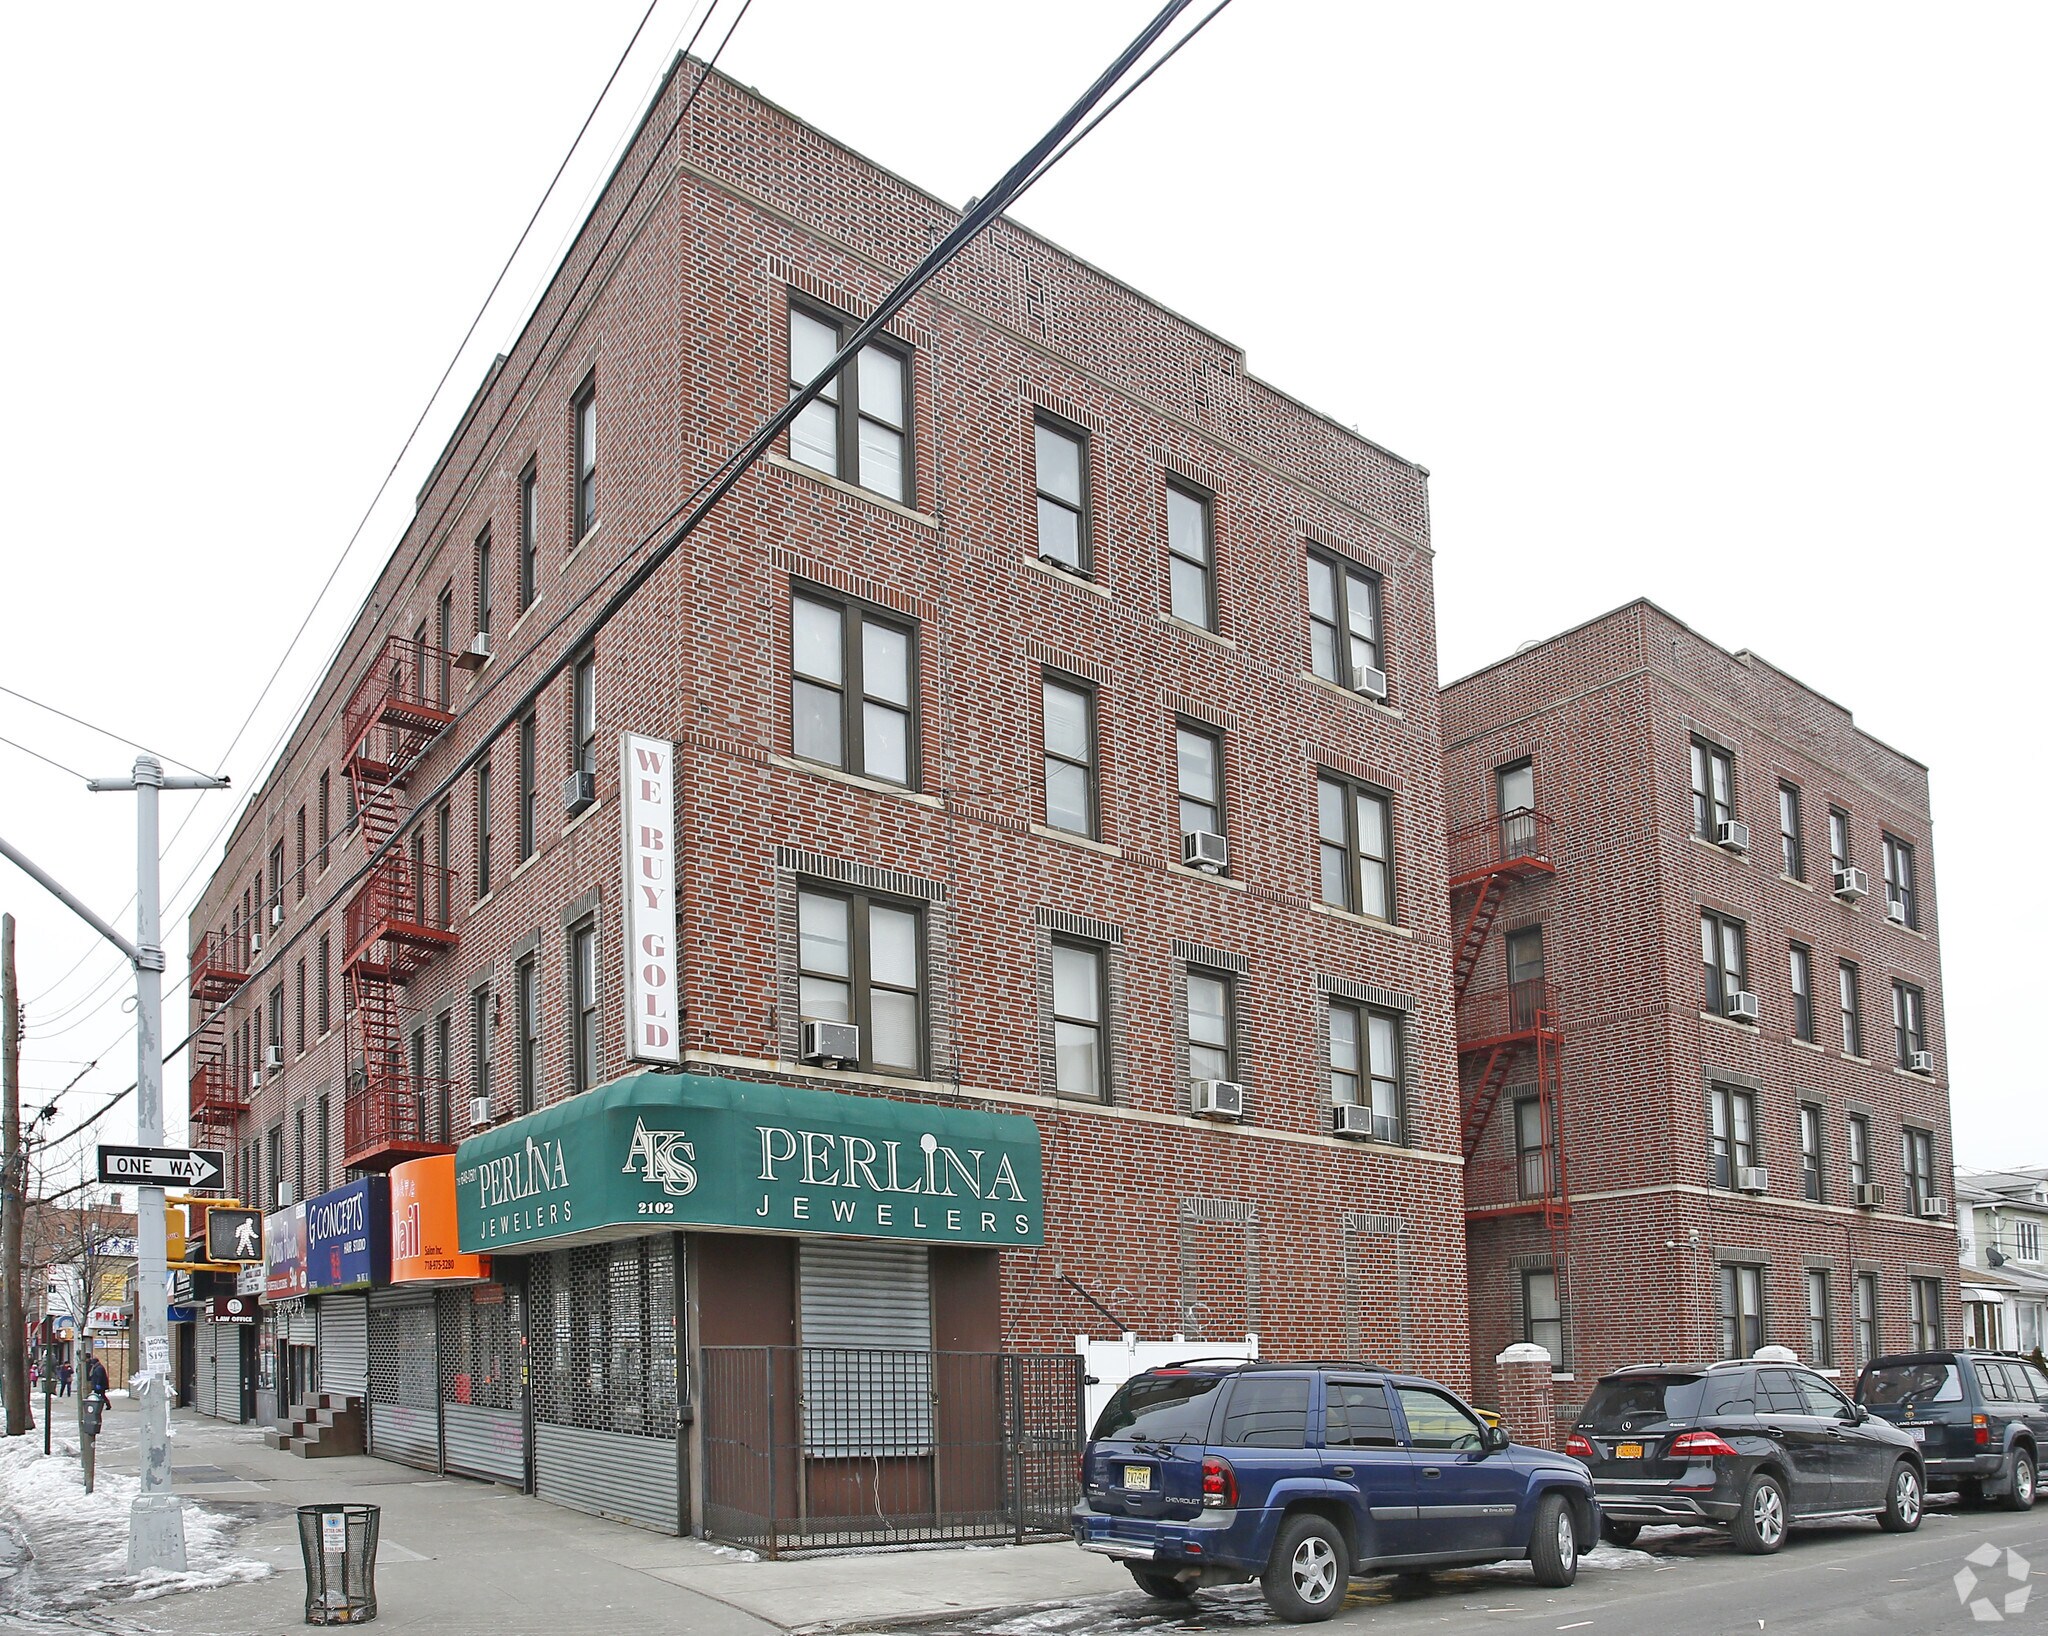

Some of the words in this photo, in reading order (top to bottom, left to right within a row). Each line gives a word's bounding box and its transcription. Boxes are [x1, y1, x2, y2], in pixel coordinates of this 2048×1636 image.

[634, 747, 667, 805] WE
[640, 825, 666, 910] BUY
[641, 933, 669, 1048] GOLD
[117, 1158, 152, 1174] ONE
[169, 1160, 205, 1176] WAY
[478, 1135, 570, 1209] PERLINA
[755, 1126, 1028, 1202] PERLINA
[316, 1191, 364, 1240] CONCEPTS
[480, 1200, 573, 1240] JEWELERS
[637, 1202, 674, 1215] 2102
[756, 1194, 1030, 1236] JEWELERS
[343, 1240, 353, 1254] HAIR
[353, 1238, 366, 1253] STUDIO
[392, 1202, 420, 1261] Nail
[424, 1245, 435, 1256] Salon
[1165, 1496, 1201, 1505] CHEVROLET
